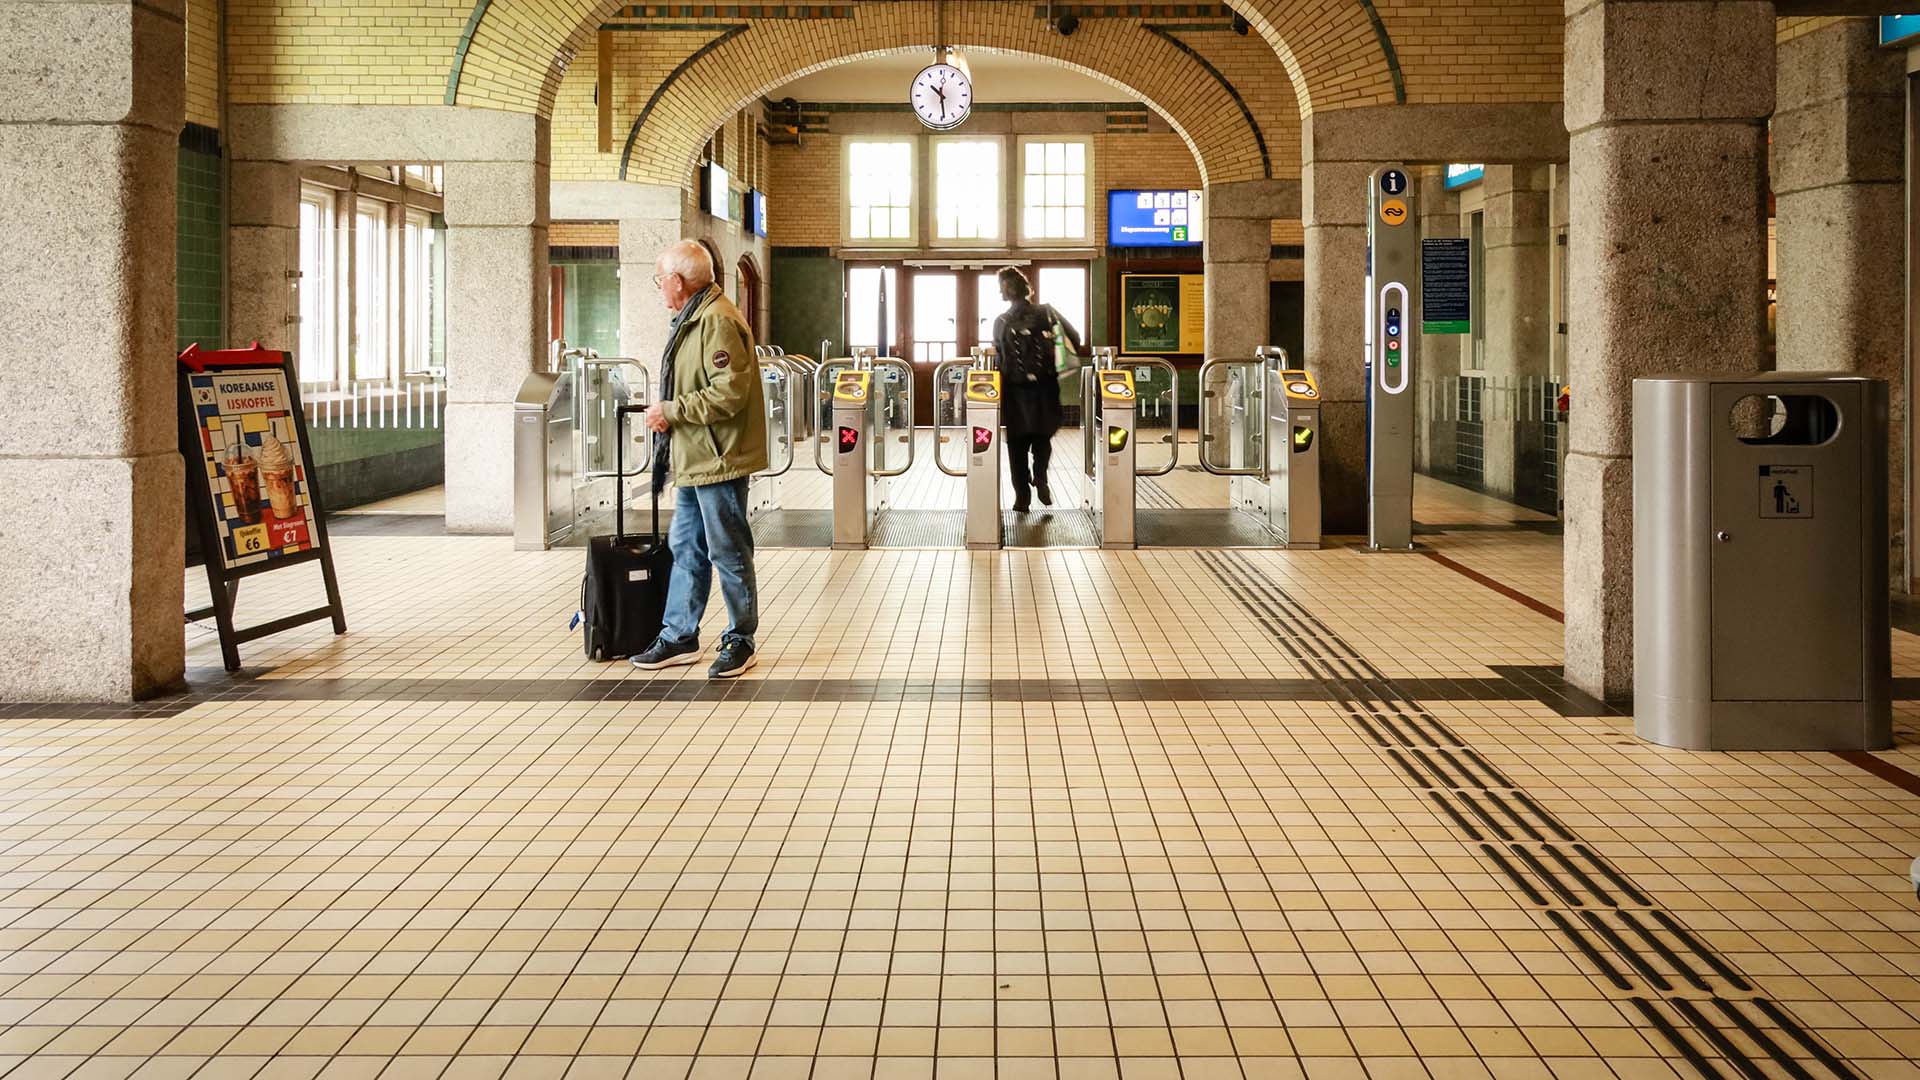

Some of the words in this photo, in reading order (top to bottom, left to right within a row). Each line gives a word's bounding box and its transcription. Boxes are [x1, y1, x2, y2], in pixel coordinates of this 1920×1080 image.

[220, 381, 275, 394] KOREAANSE
[227, 397, 275, 410] IJSKOFFIE
[283, 530, 297, 543] €7
[245, 537, 260, 551] €6
